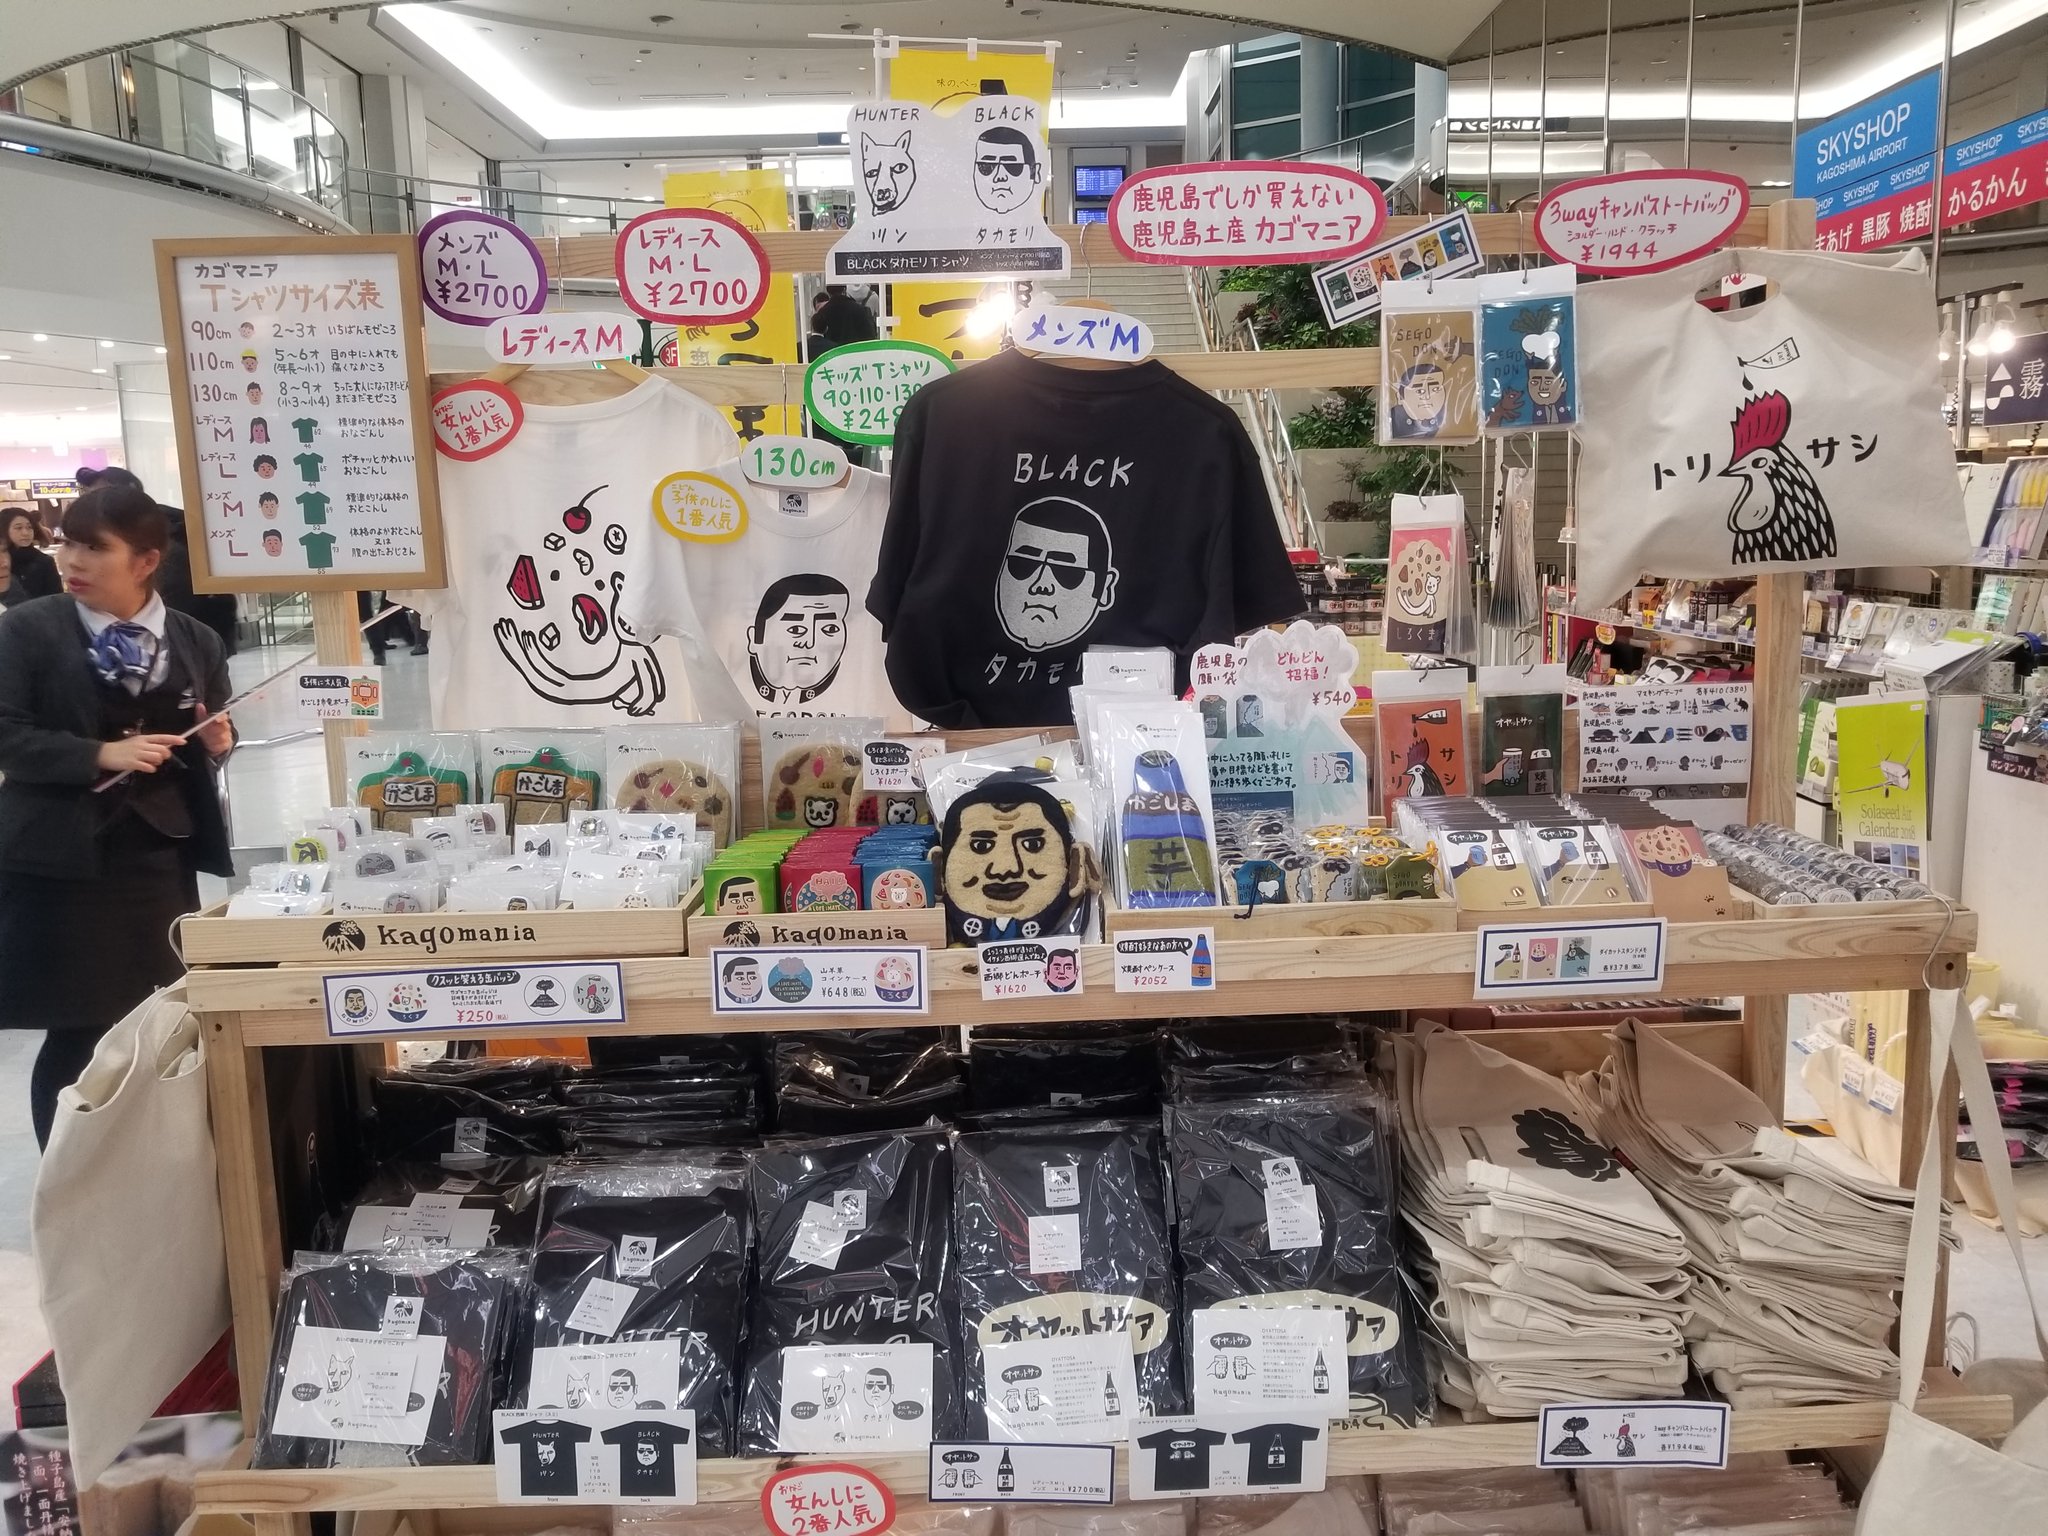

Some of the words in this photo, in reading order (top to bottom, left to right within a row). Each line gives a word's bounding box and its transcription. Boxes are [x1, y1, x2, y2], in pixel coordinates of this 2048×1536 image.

[854, 107, 921, 122] HUNTER
[974, 106, 1036, 123] BLACK
[1816, 102, 1912, 165] SKYSHOP
[1816, 157, 1867, 184] KAGOSHIMA
[1867, 136, 1909, 163] AIRPORT
[1890, 161, 1930, 186] SKYSHOP
[1956, 134, 2004, 161] SKYSHOP
[1133, 181, 1356, 213] 鹿児島でしか買えない
[1861, 211, 1891, 246] 黒豚
[1900, 198, 1932, 233] 焼酎
[1947, 167, 2027, 219] かるかん
[438, 232, 500, 256] メンズ
[639, 227, 722, 250] レディース
[975, 227, 1035, 244] タカモリ
[1581, 242, 1659, 263] ¥1944
[194, 262, 278, 278] カゴマニア
[199, 278, 385, 313] Tシャツサイズ表
[436, 279, 529, 310] ¥2700
[643, 279, 748, 308] ¥2700
[191, 320, 232, 341] 90cm
[190, 351, 234, 371] 110cm
[665, 347, 678, 364] 3F
[193, 384, 238, 403] 130cm
[195, 415, 232, 426] レディース
[214, 427, 235, 443] M
[454, 411, 510, 451] 1番人気
[200, 452, 237, 463] レディース
[754, 447, 836, 478] 130cm
[1653, 452, 1712, 492] トリ
[1806, 433, 1879, 474] サシ
[218, 463, 238, 479] L
[1013, 452, 1135, 489] BLACK
[206, 491, 232, 501] メンズ
[223, 501, 244, 518] M
[676, 508, 734, 532] 1番人気
[210, 528, 236, 539] メンズ
[228, 540, 249, 557] L
[1197, 652, 1248, 670] 鹿児島の
[1277, 651, 1325, 667] どんどん
[1312, 690, 1352, 706] ¥540
[1128, 792, 1200, 812] かごしま
[1861, 803, 1899, 821] Solaseed
[1859, 820, 1899, 838] Calendar
[377, 925, 537, 954] kagomania
[994, 984, 1027, 995] ¥1620
[1134, 976, 1168, 986] ¥2052
[457, 1010, 493, 1023] ¥250
[793, 1291, 936, 1338] HUNTER
[786, 1483, 867, 1515] 女んしに
[791, 1506, 878, 1536] 2番人気
